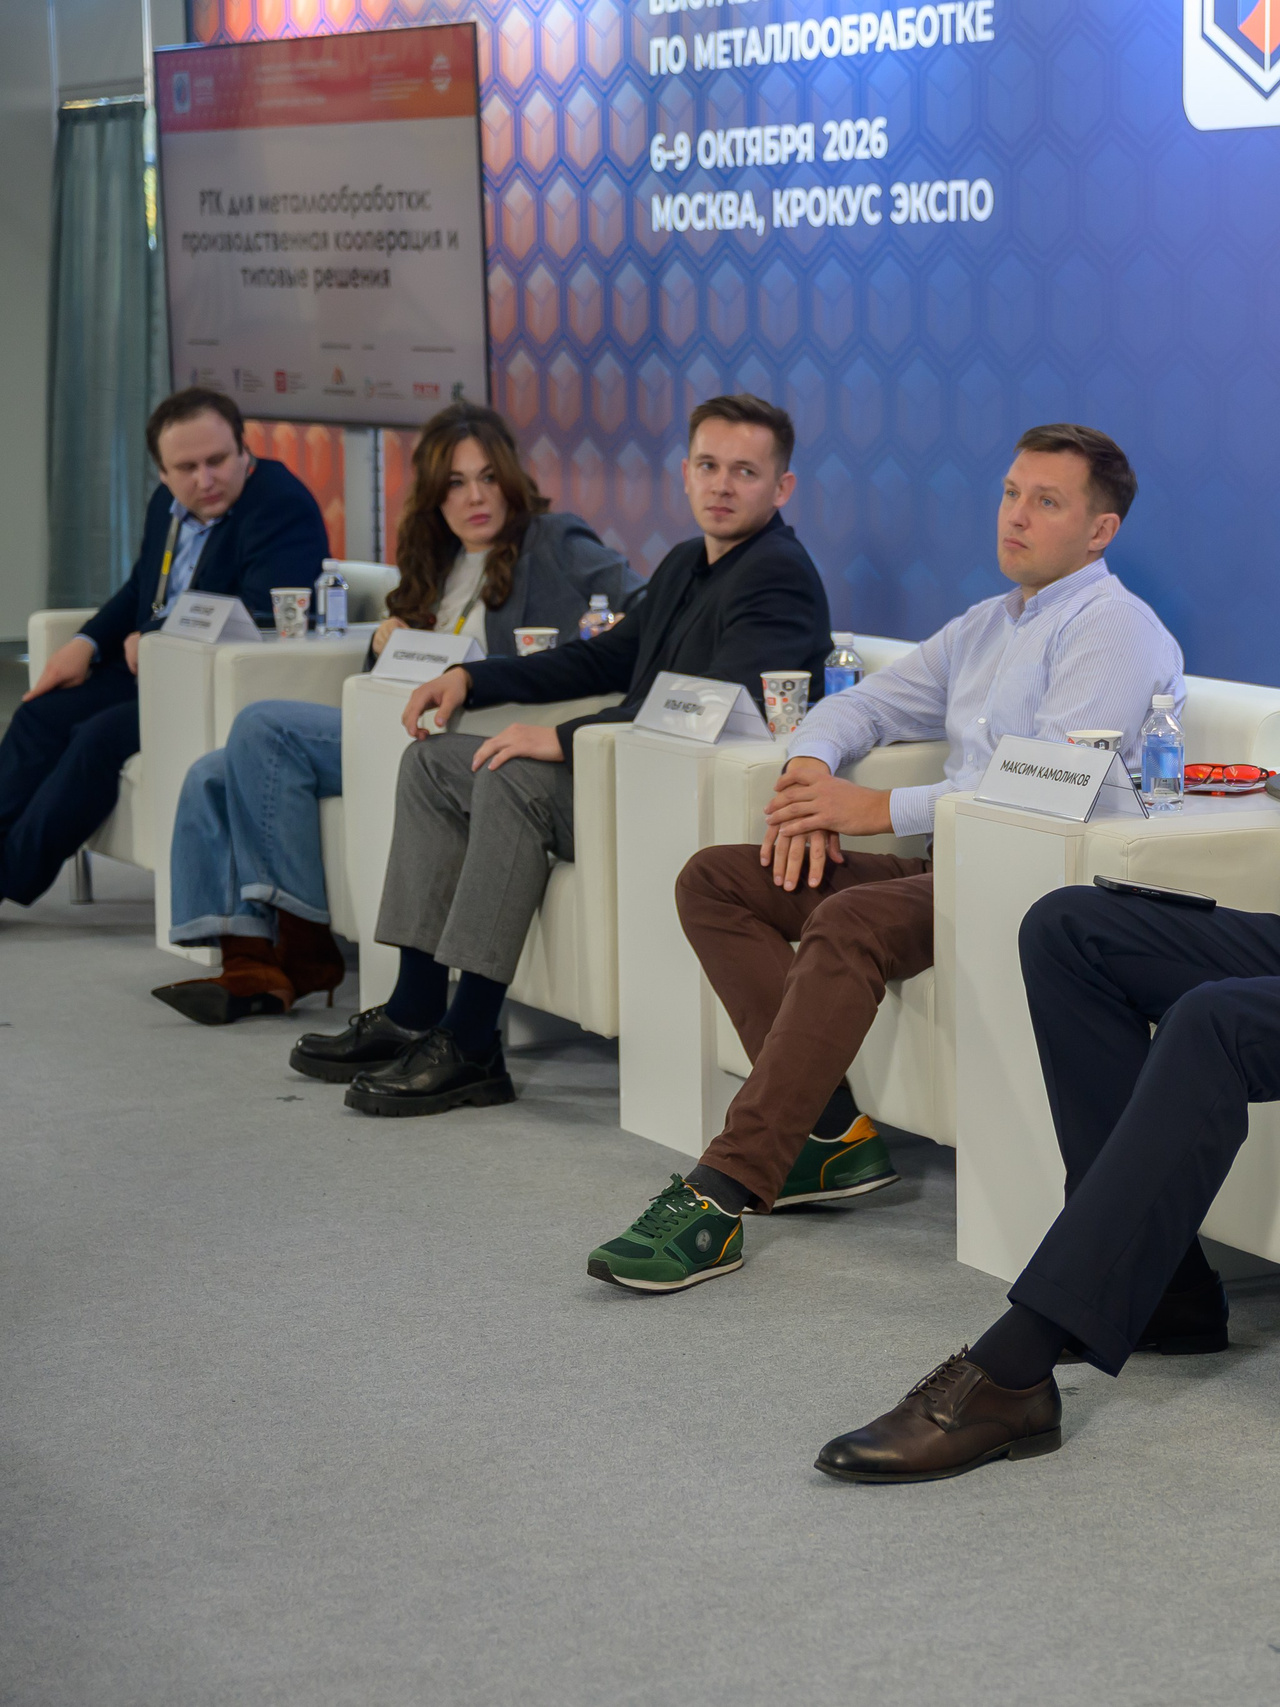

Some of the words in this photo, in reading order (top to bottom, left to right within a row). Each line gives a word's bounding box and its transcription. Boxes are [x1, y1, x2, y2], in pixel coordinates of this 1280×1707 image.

[649, 34, 688, 76] ПО
[693, 0, 995, 72] МЕТАЛЛООБРАБОТКЕ
[696, 122, 815, 169] ОКТЯБРЯ
[822, 116, 889, 162] 2026
[651, 190, 766, 236] МОСКВА,
[772, 183, 882, 229] КРОКУС
[889, 178, 995, 225] ЭКСПО
[446, 229, 460, 250] и
[1000, 760, 1038, 777] МАКСИМ
[1038, 766, 1091, 787] КАМОЛИКОВ
